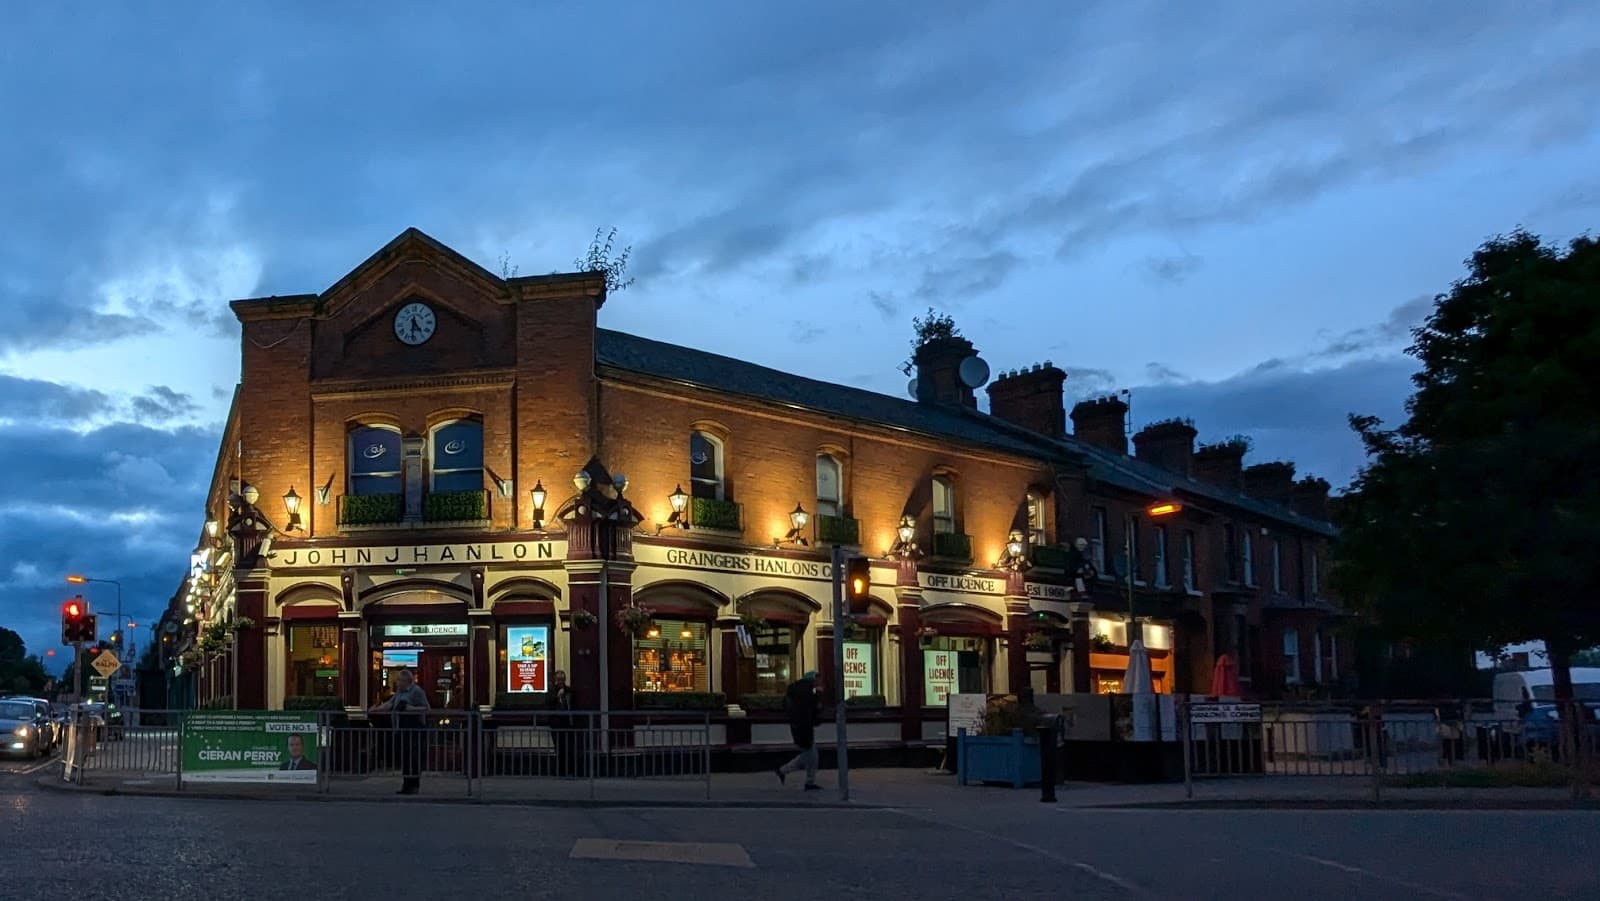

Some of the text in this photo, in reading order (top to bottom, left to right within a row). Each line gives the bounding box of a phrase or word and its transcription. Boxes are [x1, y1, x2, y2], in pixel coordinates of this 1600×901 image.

[284, 543, 552, 565] JOHN J HANLON
[667, 549, 750, 570] GRAINGERS
[755, 559, 818, 577] HANLONS
[928, 575, 995, 592] OFF LICENCE
[846, 647, 858, 659] OFF
[936, 655, 947, 666] OFF
[845, 662, 867, 674] CENCE
[929, 668, 954, 680] LICENCE
[198, 750, 282, 761] CIERAN PERRY
